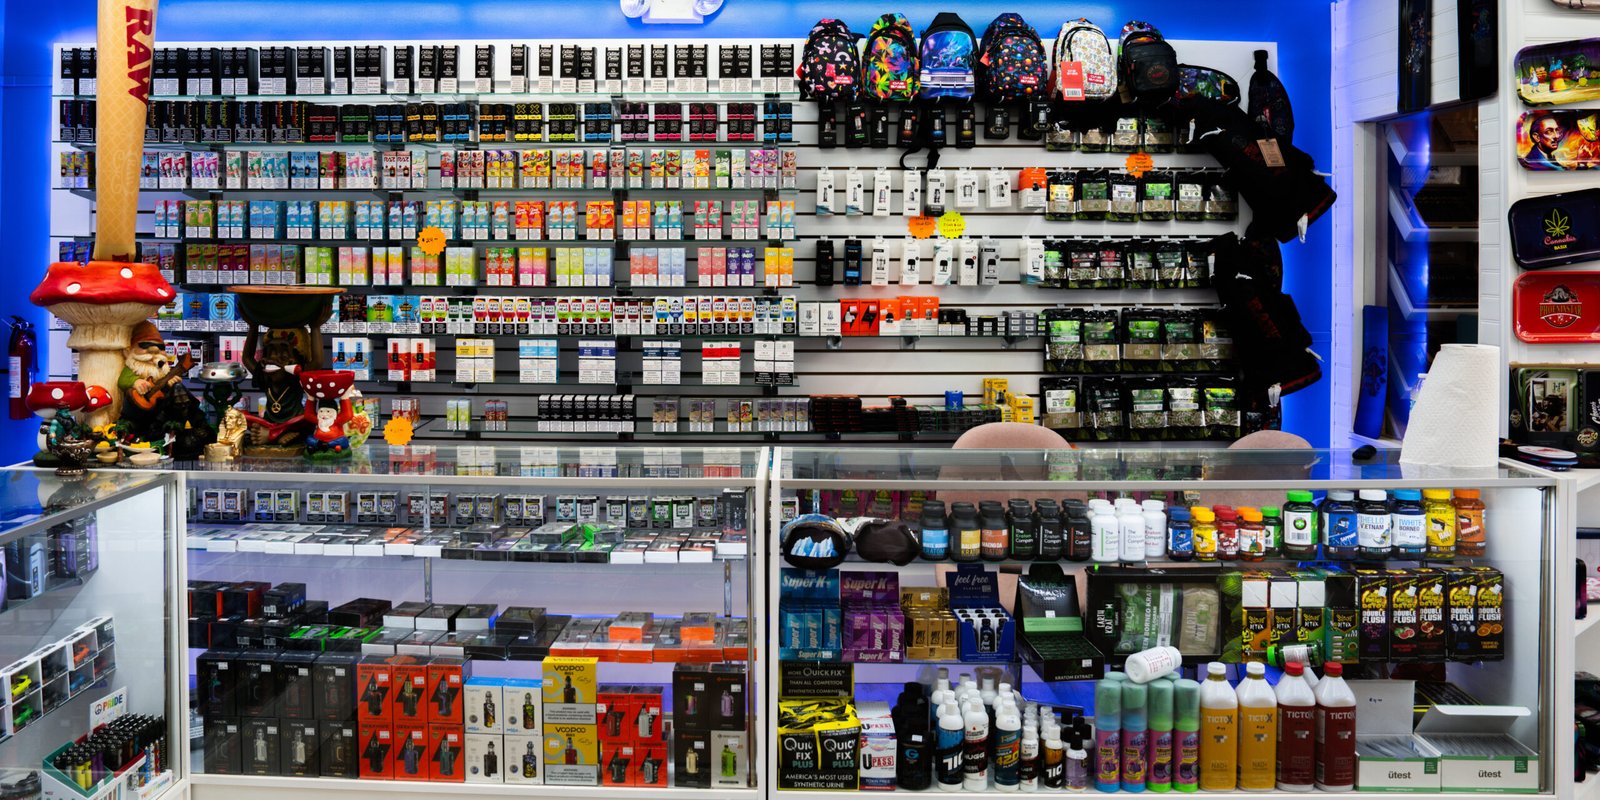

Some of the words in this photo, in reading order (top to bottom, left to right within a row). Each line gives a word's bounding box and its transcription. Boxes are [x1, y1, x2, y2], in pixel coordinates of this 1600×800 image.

[126, 5, 153, 107] RAW
[1544, 234, 1576, 245] Cannabis
[782, 575, 812, 588] Super
[815, 576, 826, 588] K
[844, 578, 874, 590] Super
[877, 578, 888, 589] K
[955, 576, 969, 585] feel
[972, 576, 988, 585] free
[858, 652, 877, 660] Super
[803, 668, 828, 676] QUICK
[103, 694, 122, 711] PRIDE
[1208, 715, 1232, 724] TICTOX
[1248, 714, 1272, 722] TICTOX
[1046, 764, 1062, 778] 710
